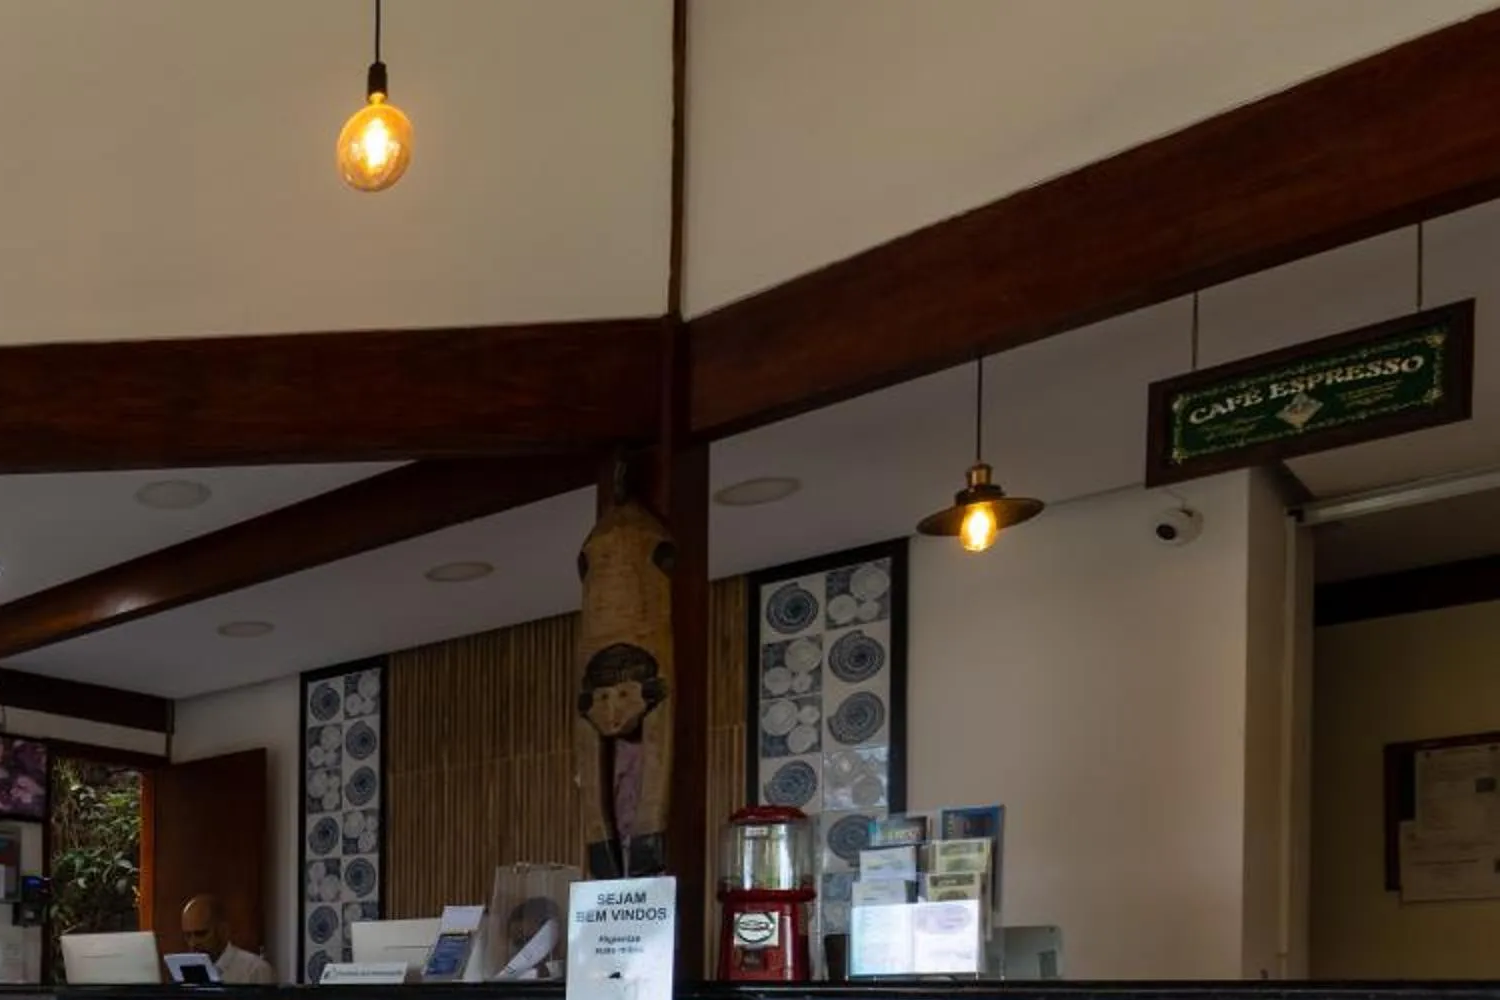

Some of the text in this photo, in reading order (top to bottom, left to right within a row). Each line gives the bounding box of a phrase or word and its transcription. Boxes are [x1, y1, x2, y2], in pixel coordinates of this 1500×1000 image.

[1269, 353, 1425, 399] ESPRESSO
[596, 891, 648, 906] SEJAM
[575, 907, 668, 923] BEM VINDOS
